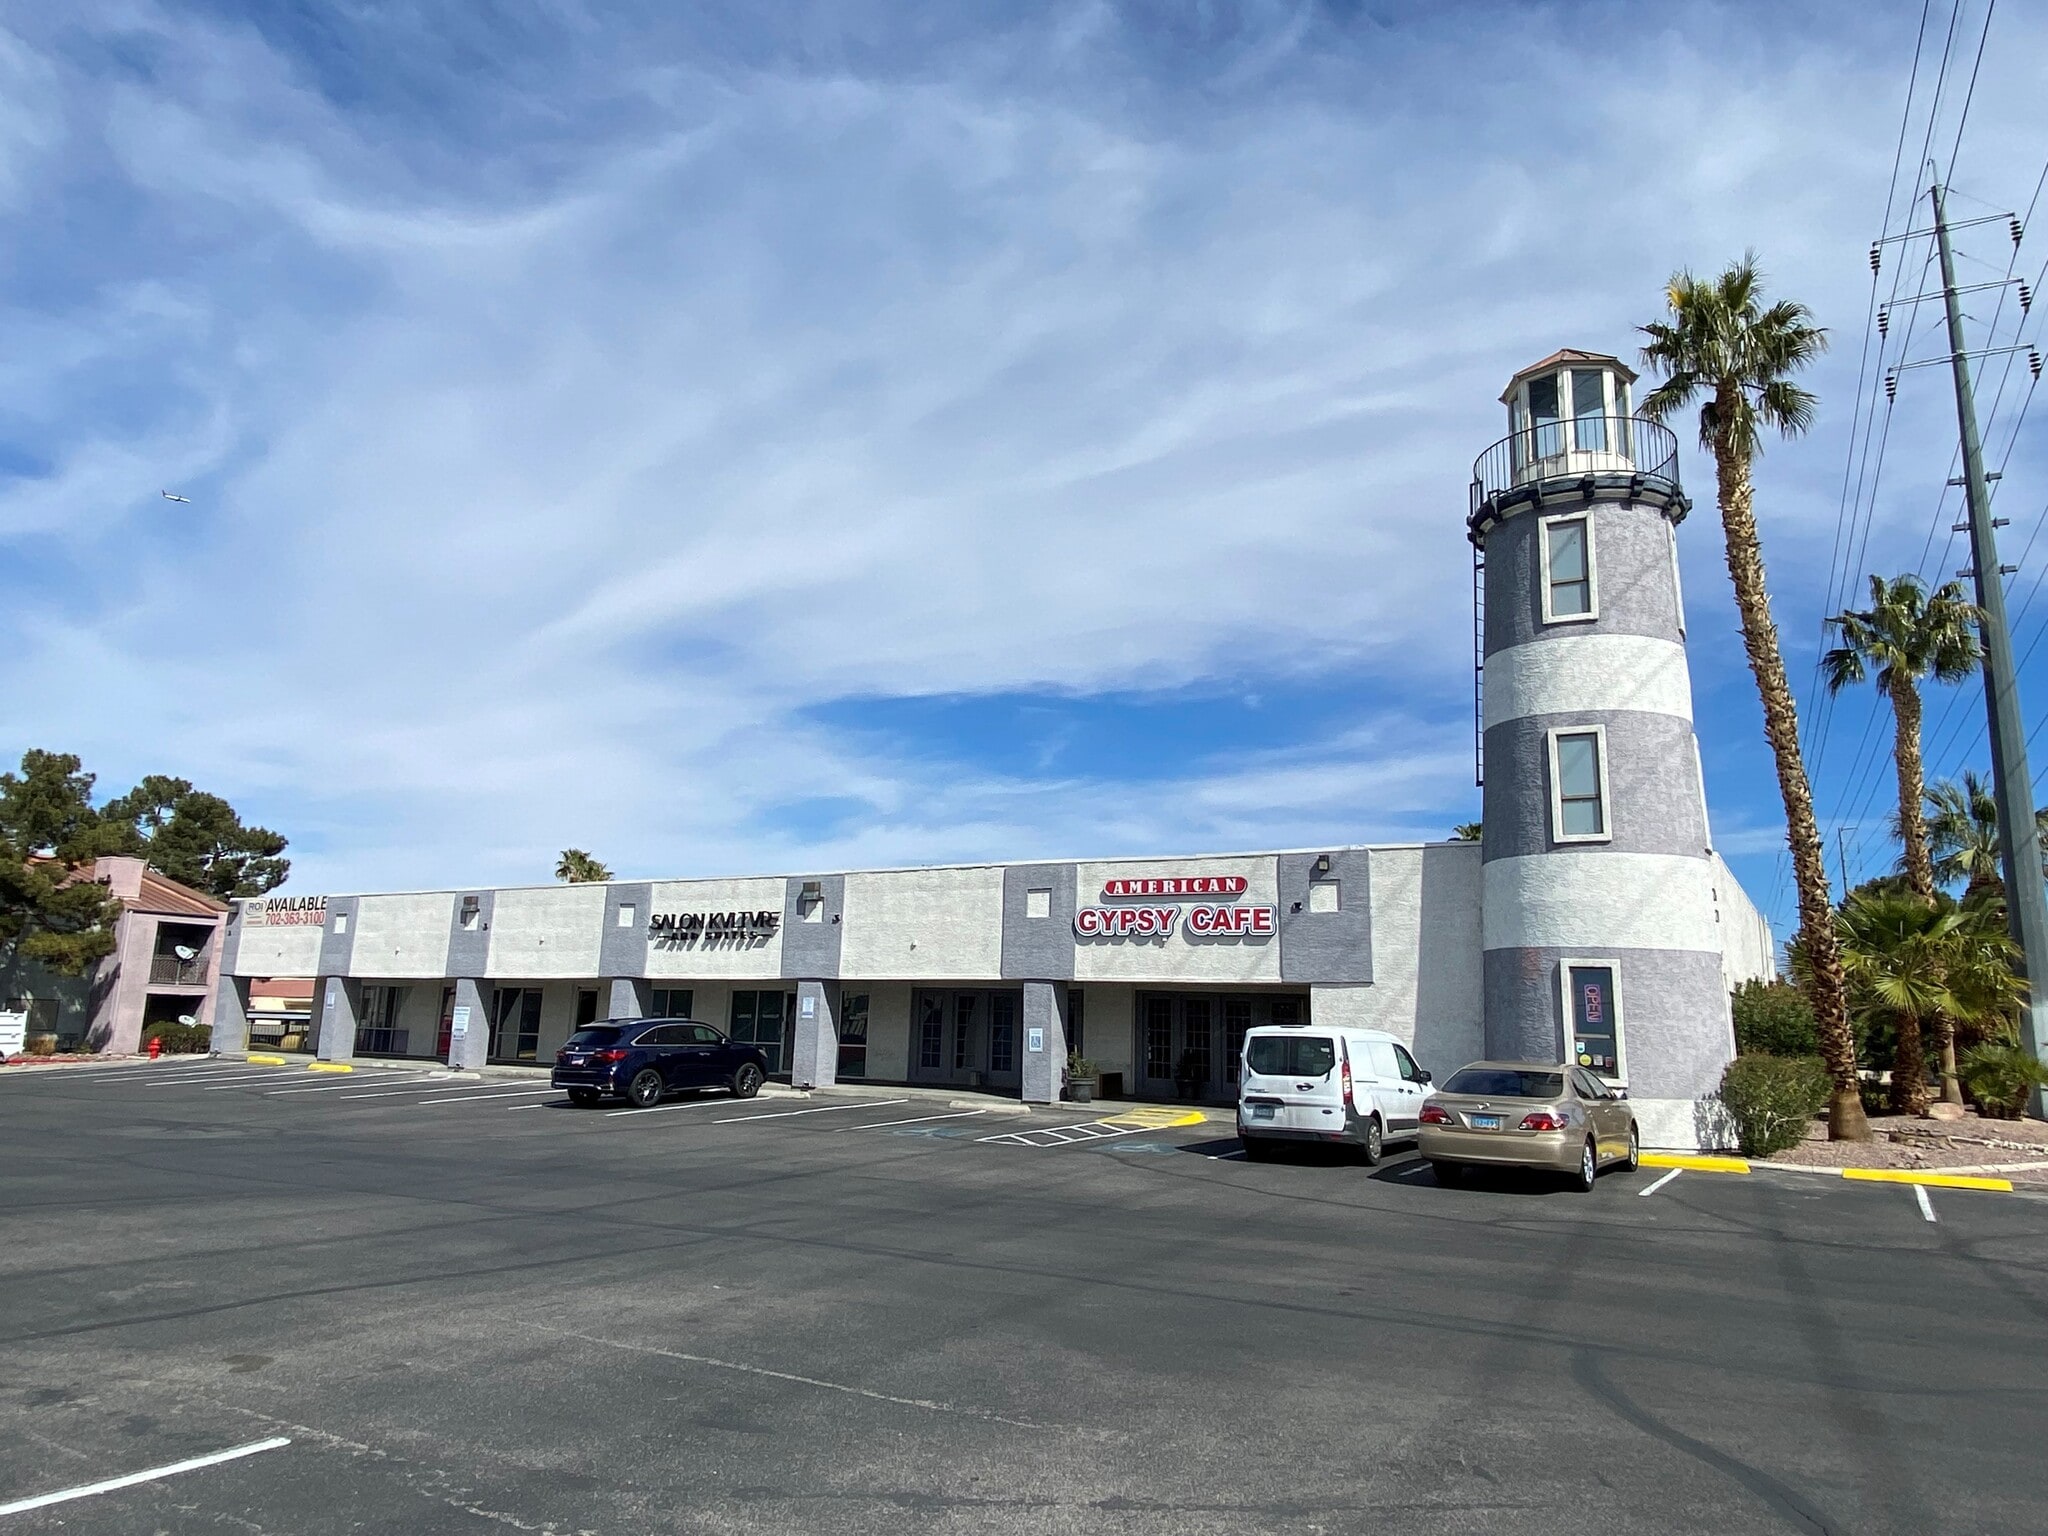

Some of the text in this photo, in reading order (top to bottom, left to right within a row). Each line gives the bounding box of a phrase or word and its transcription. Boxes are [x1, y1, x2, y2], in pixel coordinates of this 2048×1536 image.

[1112, 878, 1237, 895] AMERICAN
[248, 902, 264, 911] ROI
[265, 896, 328, 913] AVAILABLE
[265, 911, 325, 925] 702-363-3100
[648, 913, 706, 930] SALON
[1077, 908, 1272, 932] GYPSY CAFE
[704, 931, 758, 940] SUITES
[1586, 986, 1601, 1021] OPEN
